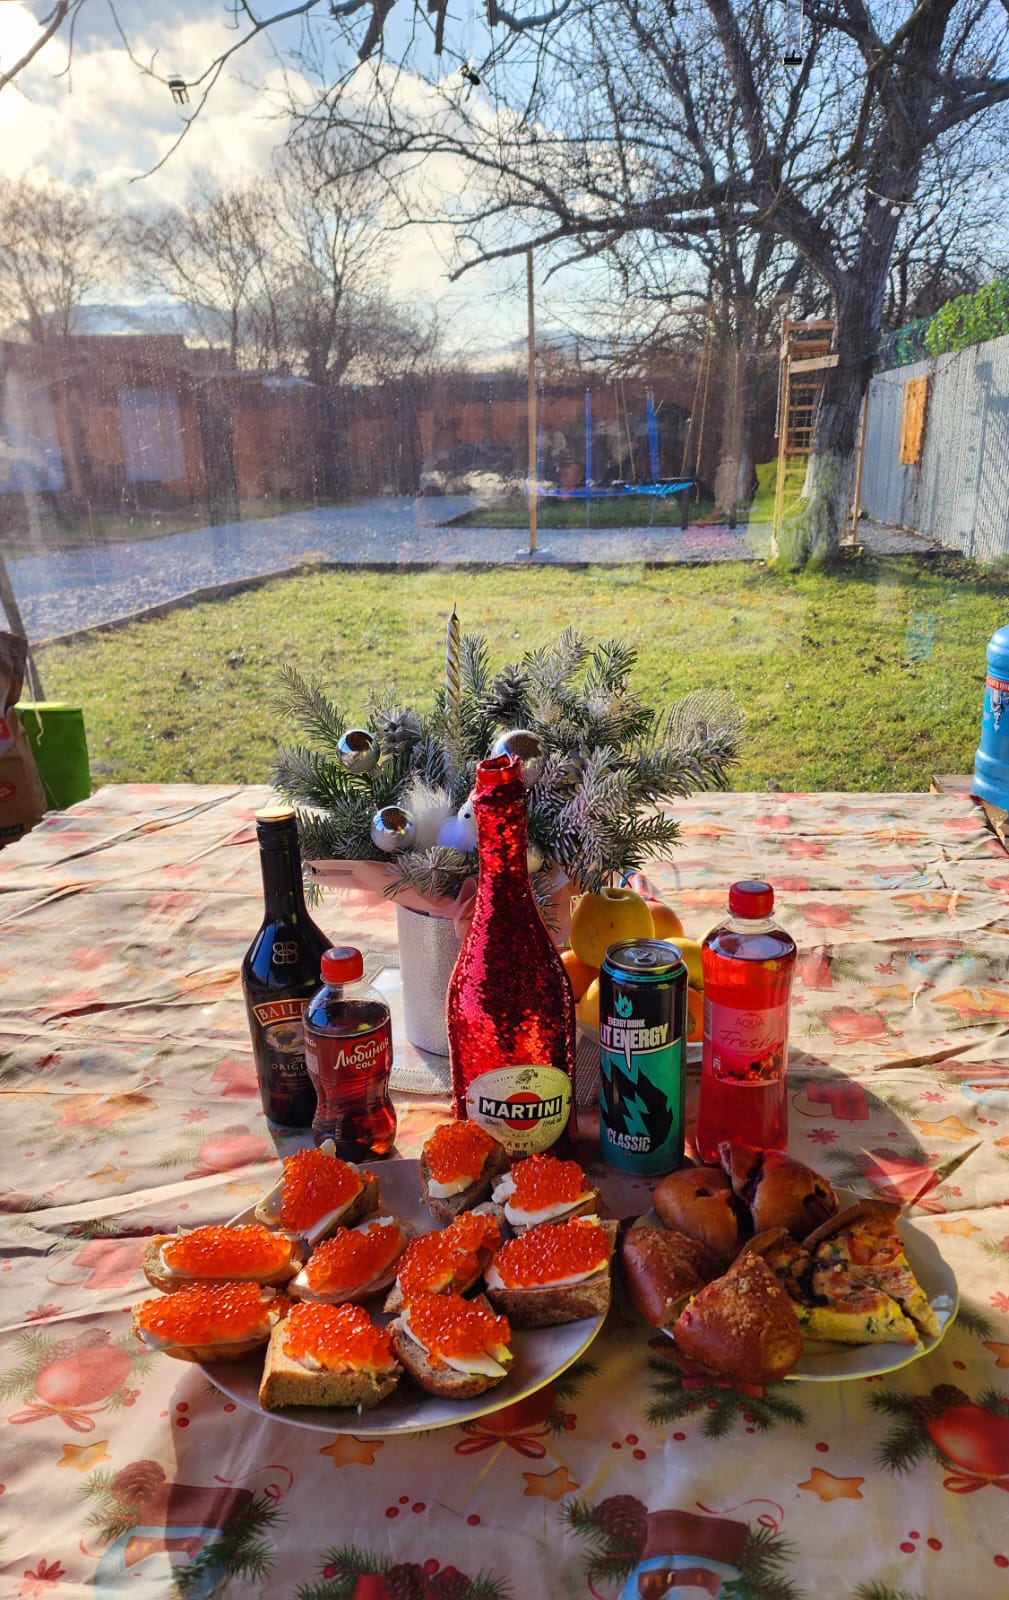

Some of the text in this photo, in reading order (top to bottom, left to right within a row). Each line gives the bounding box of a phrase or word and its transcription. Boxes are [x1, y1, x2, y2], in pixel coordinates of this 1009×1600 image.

[735, 1016, 765, 1029] AQUA
[612, 1023, 669, 1069] ENERGY
[355, 1059, 377, 1070] COLA
[481, 1098, 560, 1119] MARTINI
[607, 1127, 652, 1152] CLASSIC
